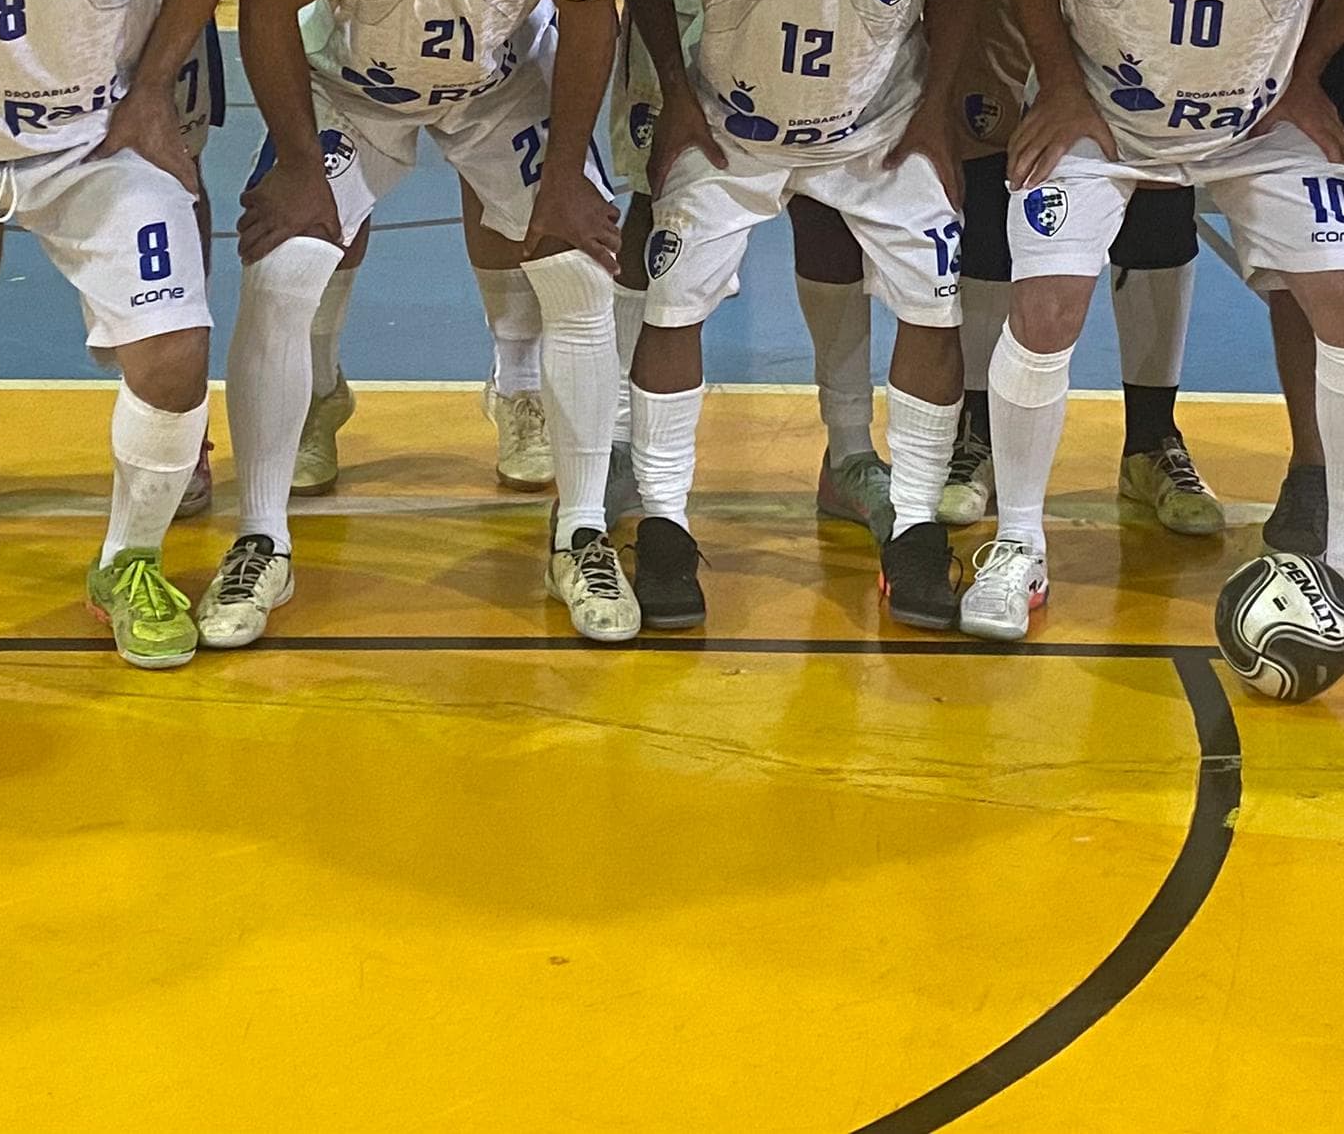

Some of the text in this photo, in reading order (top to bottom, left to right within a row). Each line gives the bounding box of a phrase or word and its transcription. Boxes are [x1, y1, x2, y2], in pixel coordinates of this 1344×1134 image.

[420, 16, 475, 62] 21
[780, 22, 834, 78] 12
[512, 118, 551, 187] 2
[137, 221, 171, 282] 8
[1277, 561, 1341, 635] PENALTY
